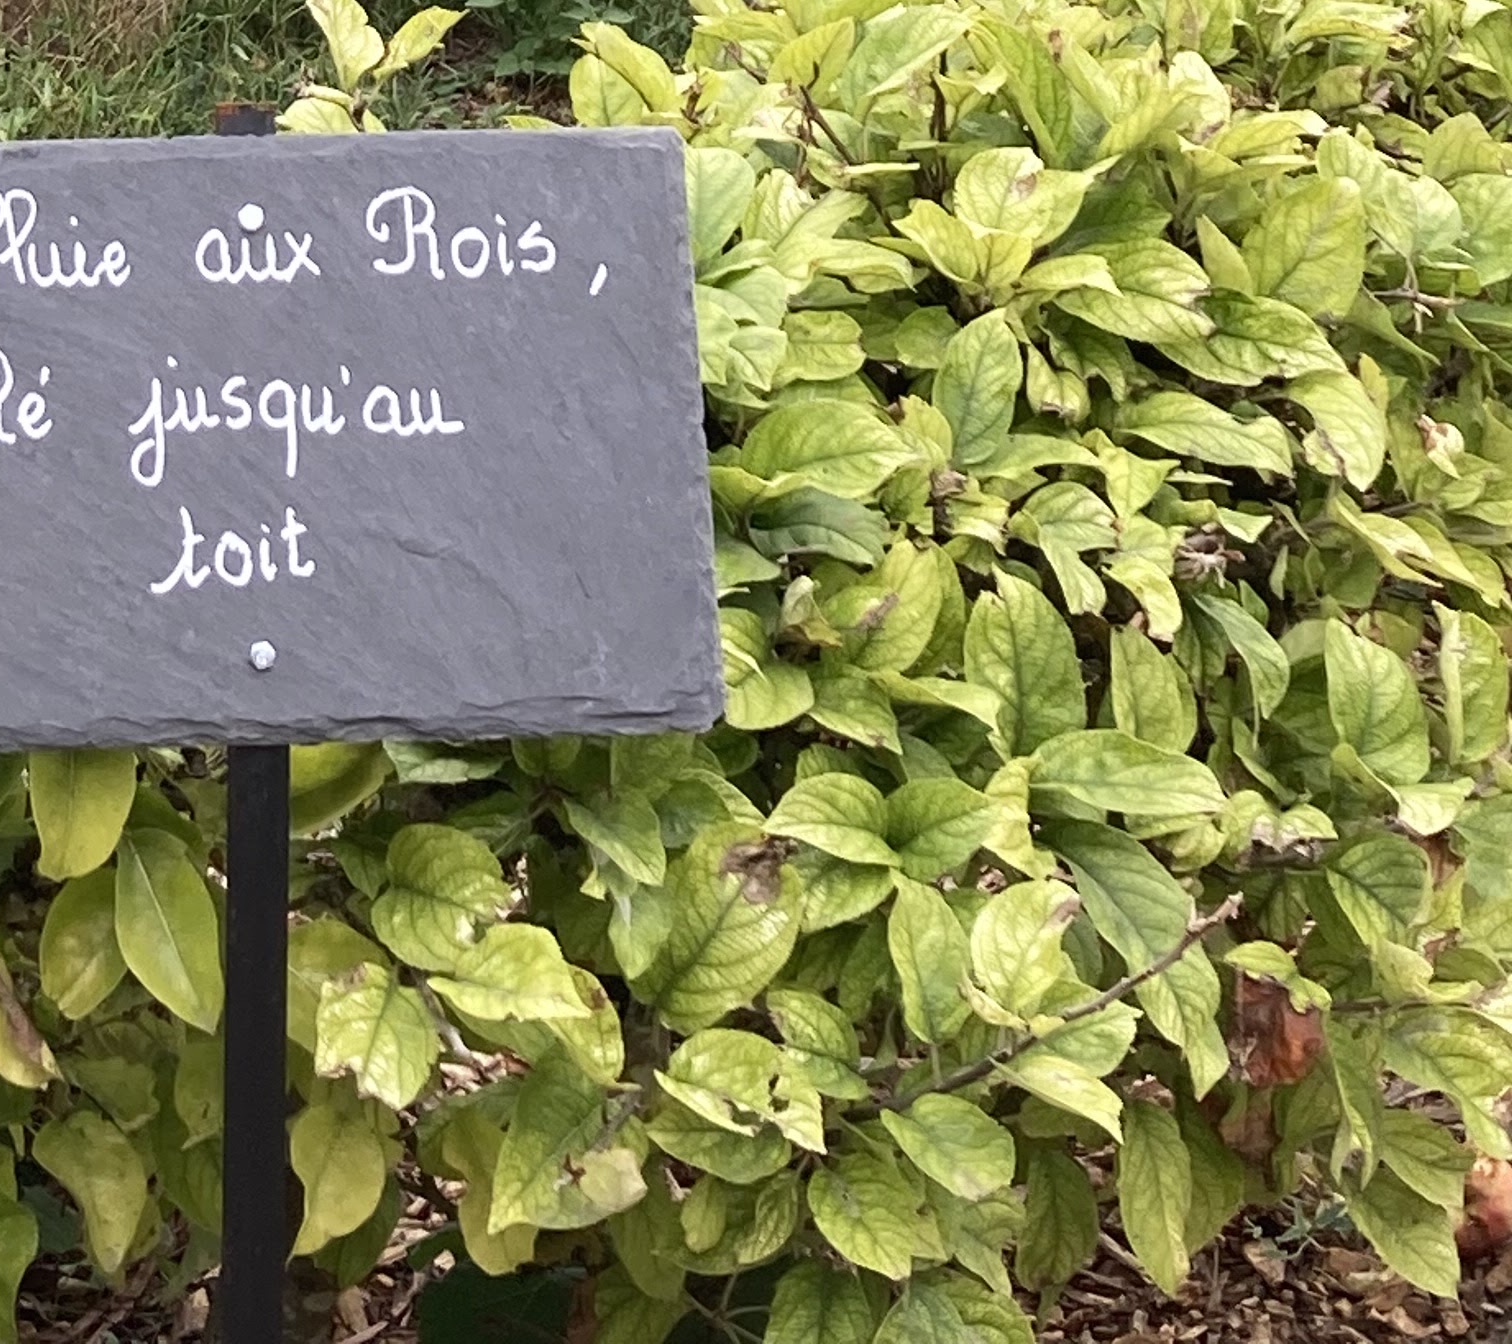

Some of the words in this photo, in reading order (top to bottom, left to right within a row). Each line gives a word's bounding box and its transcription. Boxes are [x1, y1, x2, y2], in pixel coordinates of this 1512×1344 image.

[195, 224, 321, 285] aux
[127, 355, 465, 487] jusqu'au
[150, 505, 315, 595] toit
